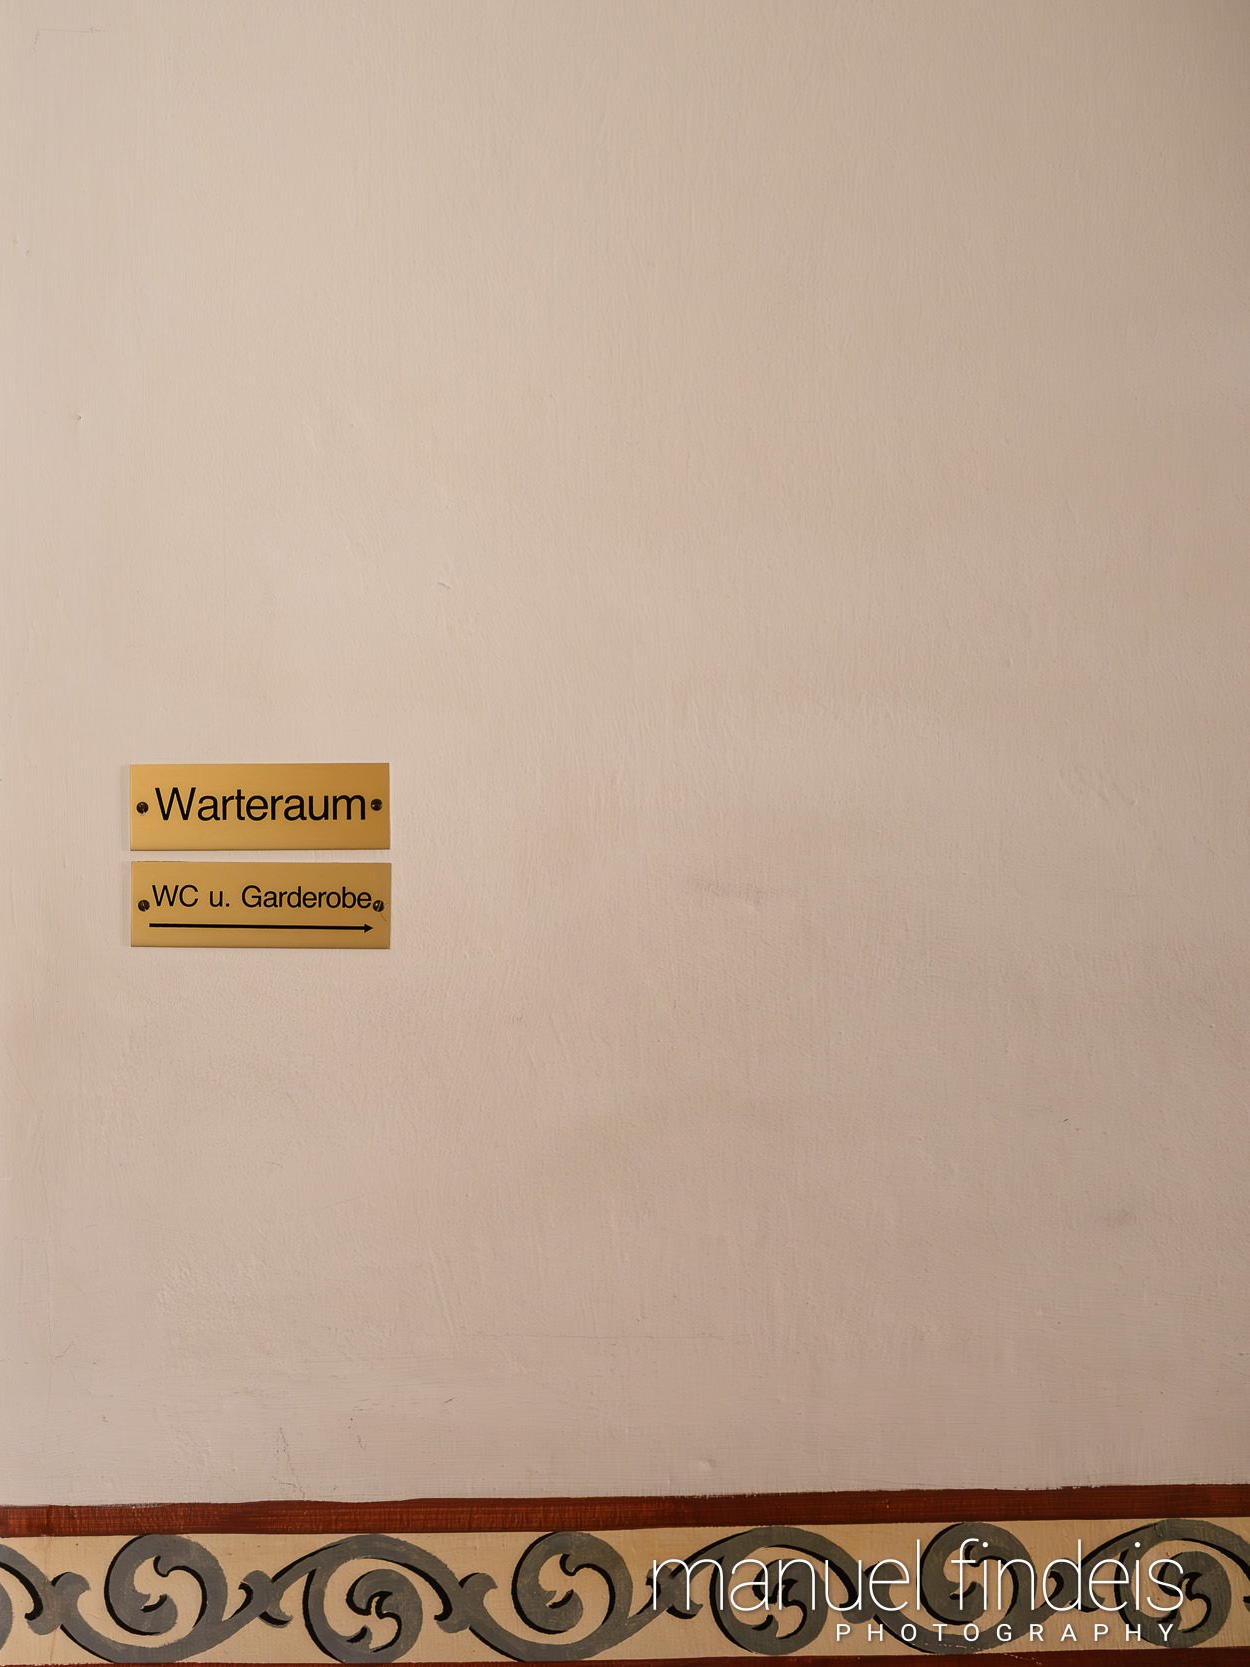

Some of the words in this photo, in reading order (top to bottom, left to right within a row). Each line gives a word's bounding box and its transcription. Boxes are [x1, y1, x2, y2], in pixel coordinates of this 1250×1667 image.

[154, 786, 366, 821] Warteraum
[151, 884, 199, 907] WC
[209, 890, 230, 907] u.
[241, 885, 372, 909] Garderobe
